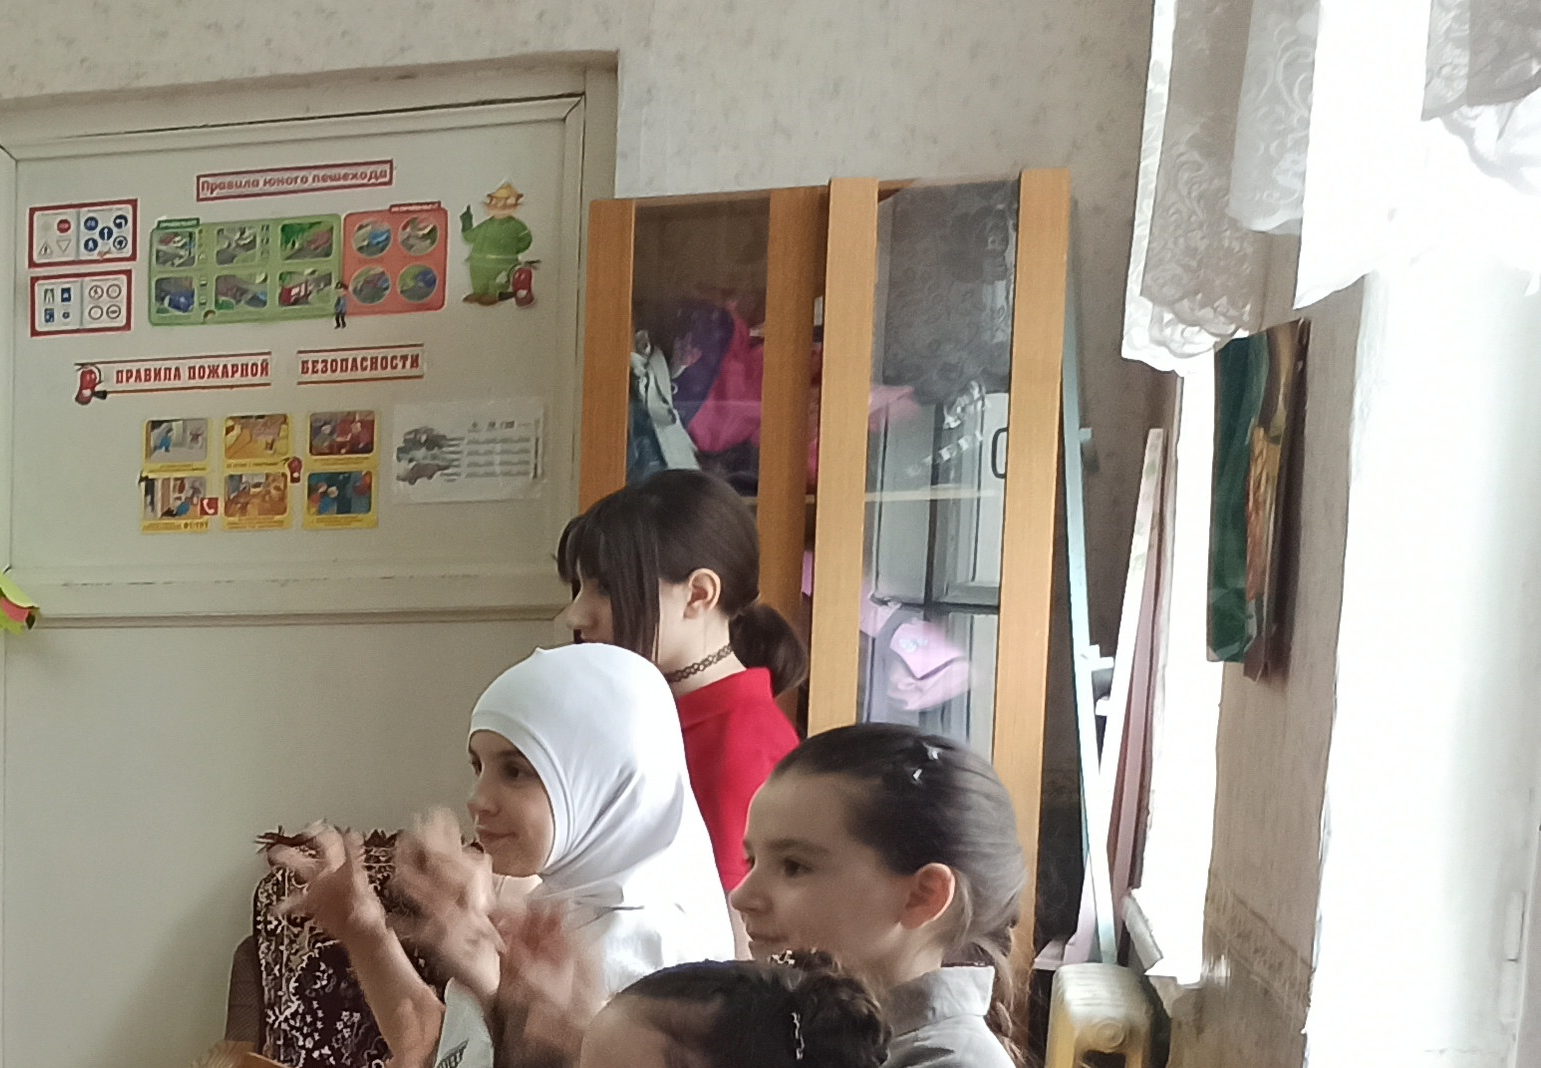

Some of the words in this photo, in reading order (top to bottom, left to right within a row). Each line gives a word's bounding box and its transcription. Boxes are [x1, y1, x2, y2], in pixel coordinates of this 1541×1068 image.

[200, 179, 260, 196] Правила
[262, 174, 308, 188] юного
[311, 167, 388, 184] пешехода
[115, 364, 182, 385] ПРАВИЛА
[187, 357, 270, 381] ПОЖАРНОЙ
[300, 352, 421, 375] БЕЗОПАСНОСТИ
